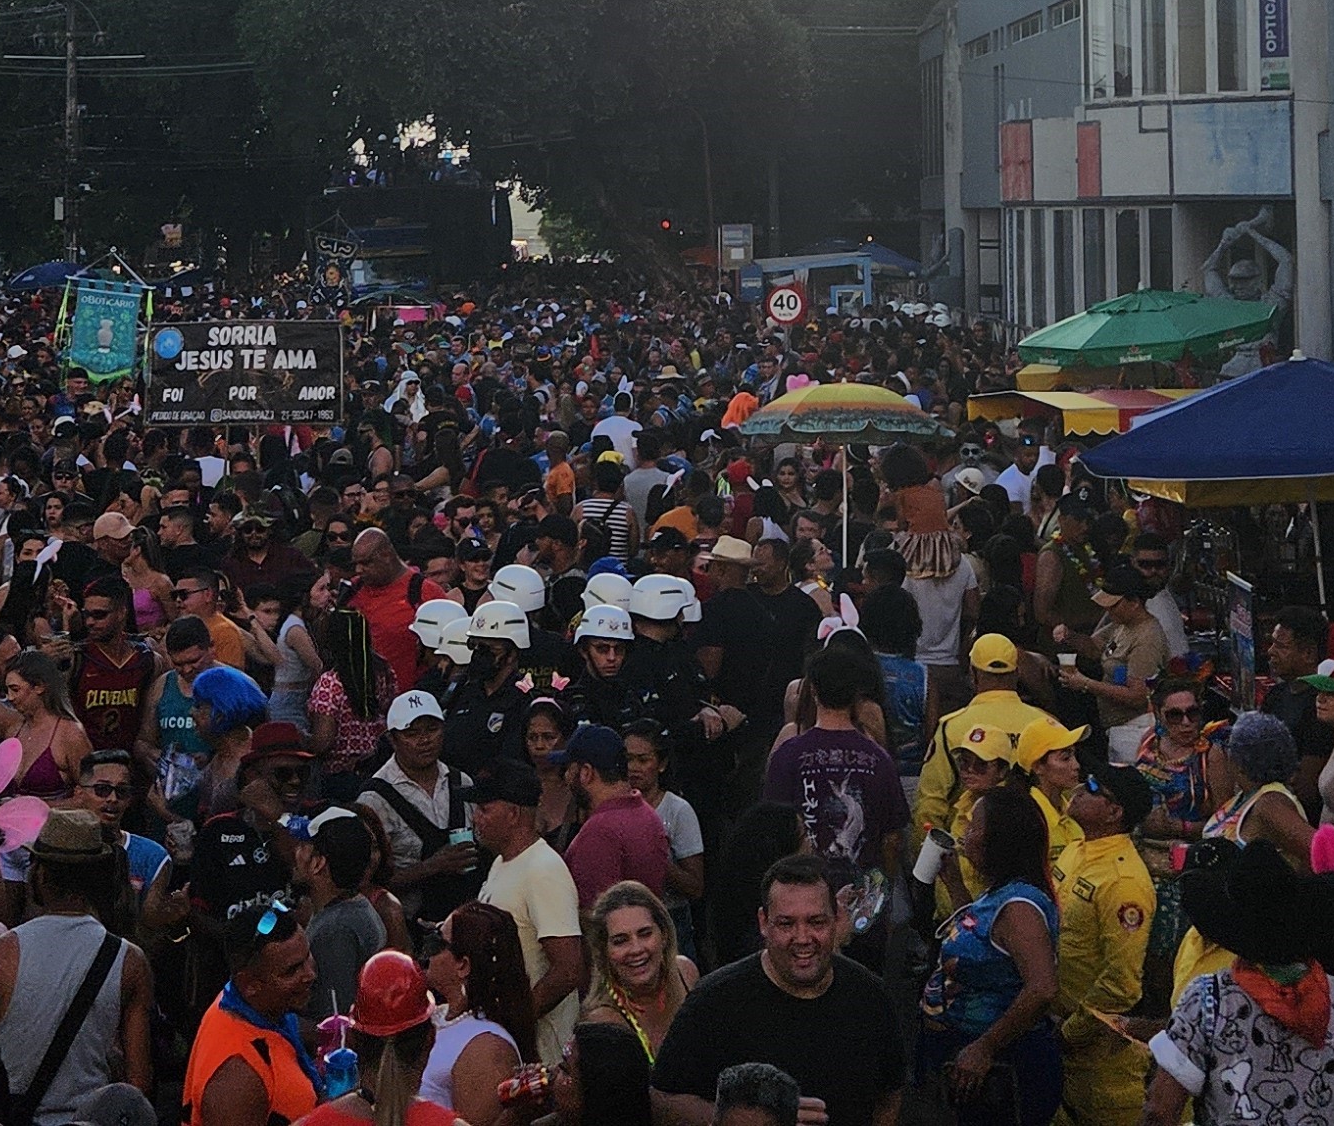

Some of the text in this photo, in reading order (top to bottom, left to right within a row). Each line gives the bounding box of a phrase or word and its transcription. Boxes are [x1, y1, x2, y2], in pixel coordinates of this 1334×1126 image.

[773, 294, 798, 311] 40
[207, 325, 278, 347] SORRIA
[175, 349, 318, 371] JESUS TE AMA
[162, 385, 336, 403] FOI POR AMOR
